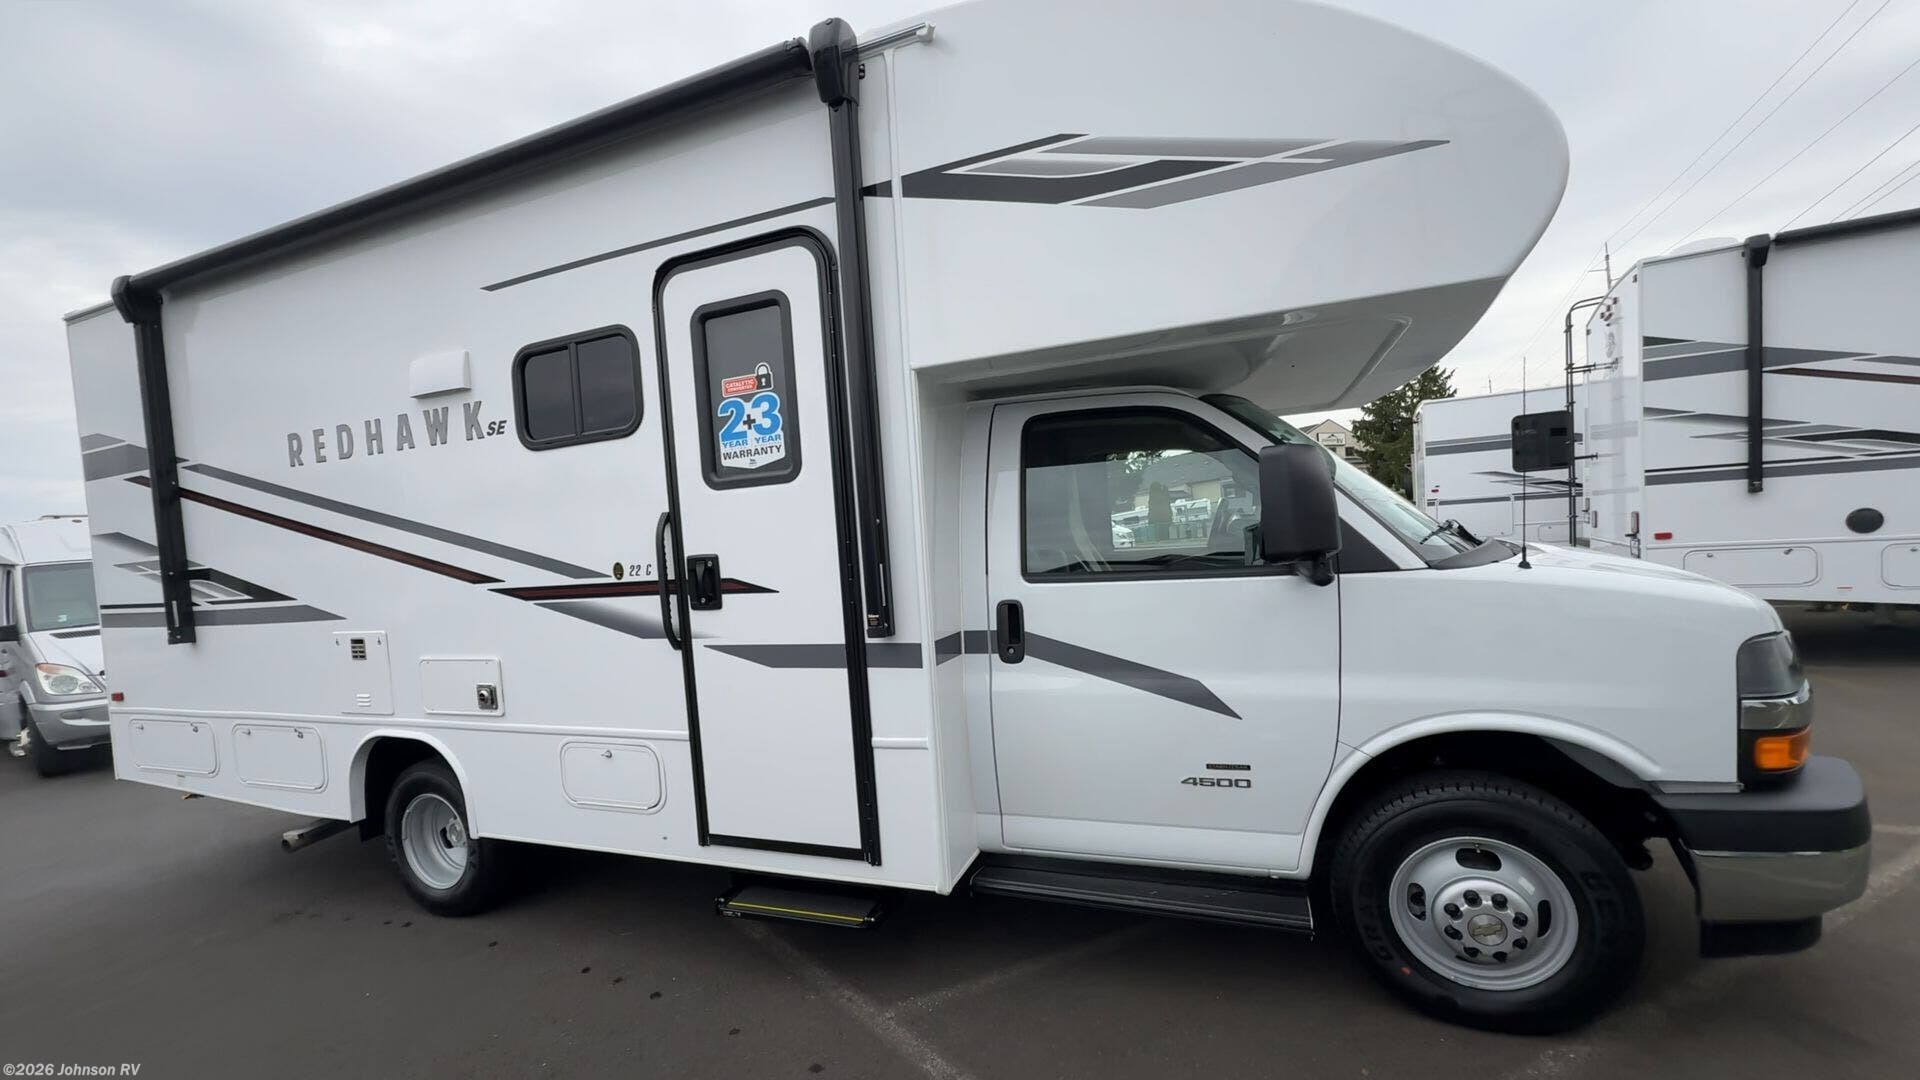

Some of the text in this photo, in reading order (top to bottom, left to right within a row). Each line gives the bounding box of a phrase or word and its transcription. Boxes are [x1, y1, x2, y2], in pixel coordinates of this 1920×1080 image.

[725, 378, 755, 389] CATALYTIC
[287, 400, 507, 468] REDHAWK SE
[722, 434, 781, 449] YEAR YEAR
[722, 445, 782, 461] WARRANTY
[629, 564, 641, 577] 22
[1181, 777, 1252, 788] 4500
